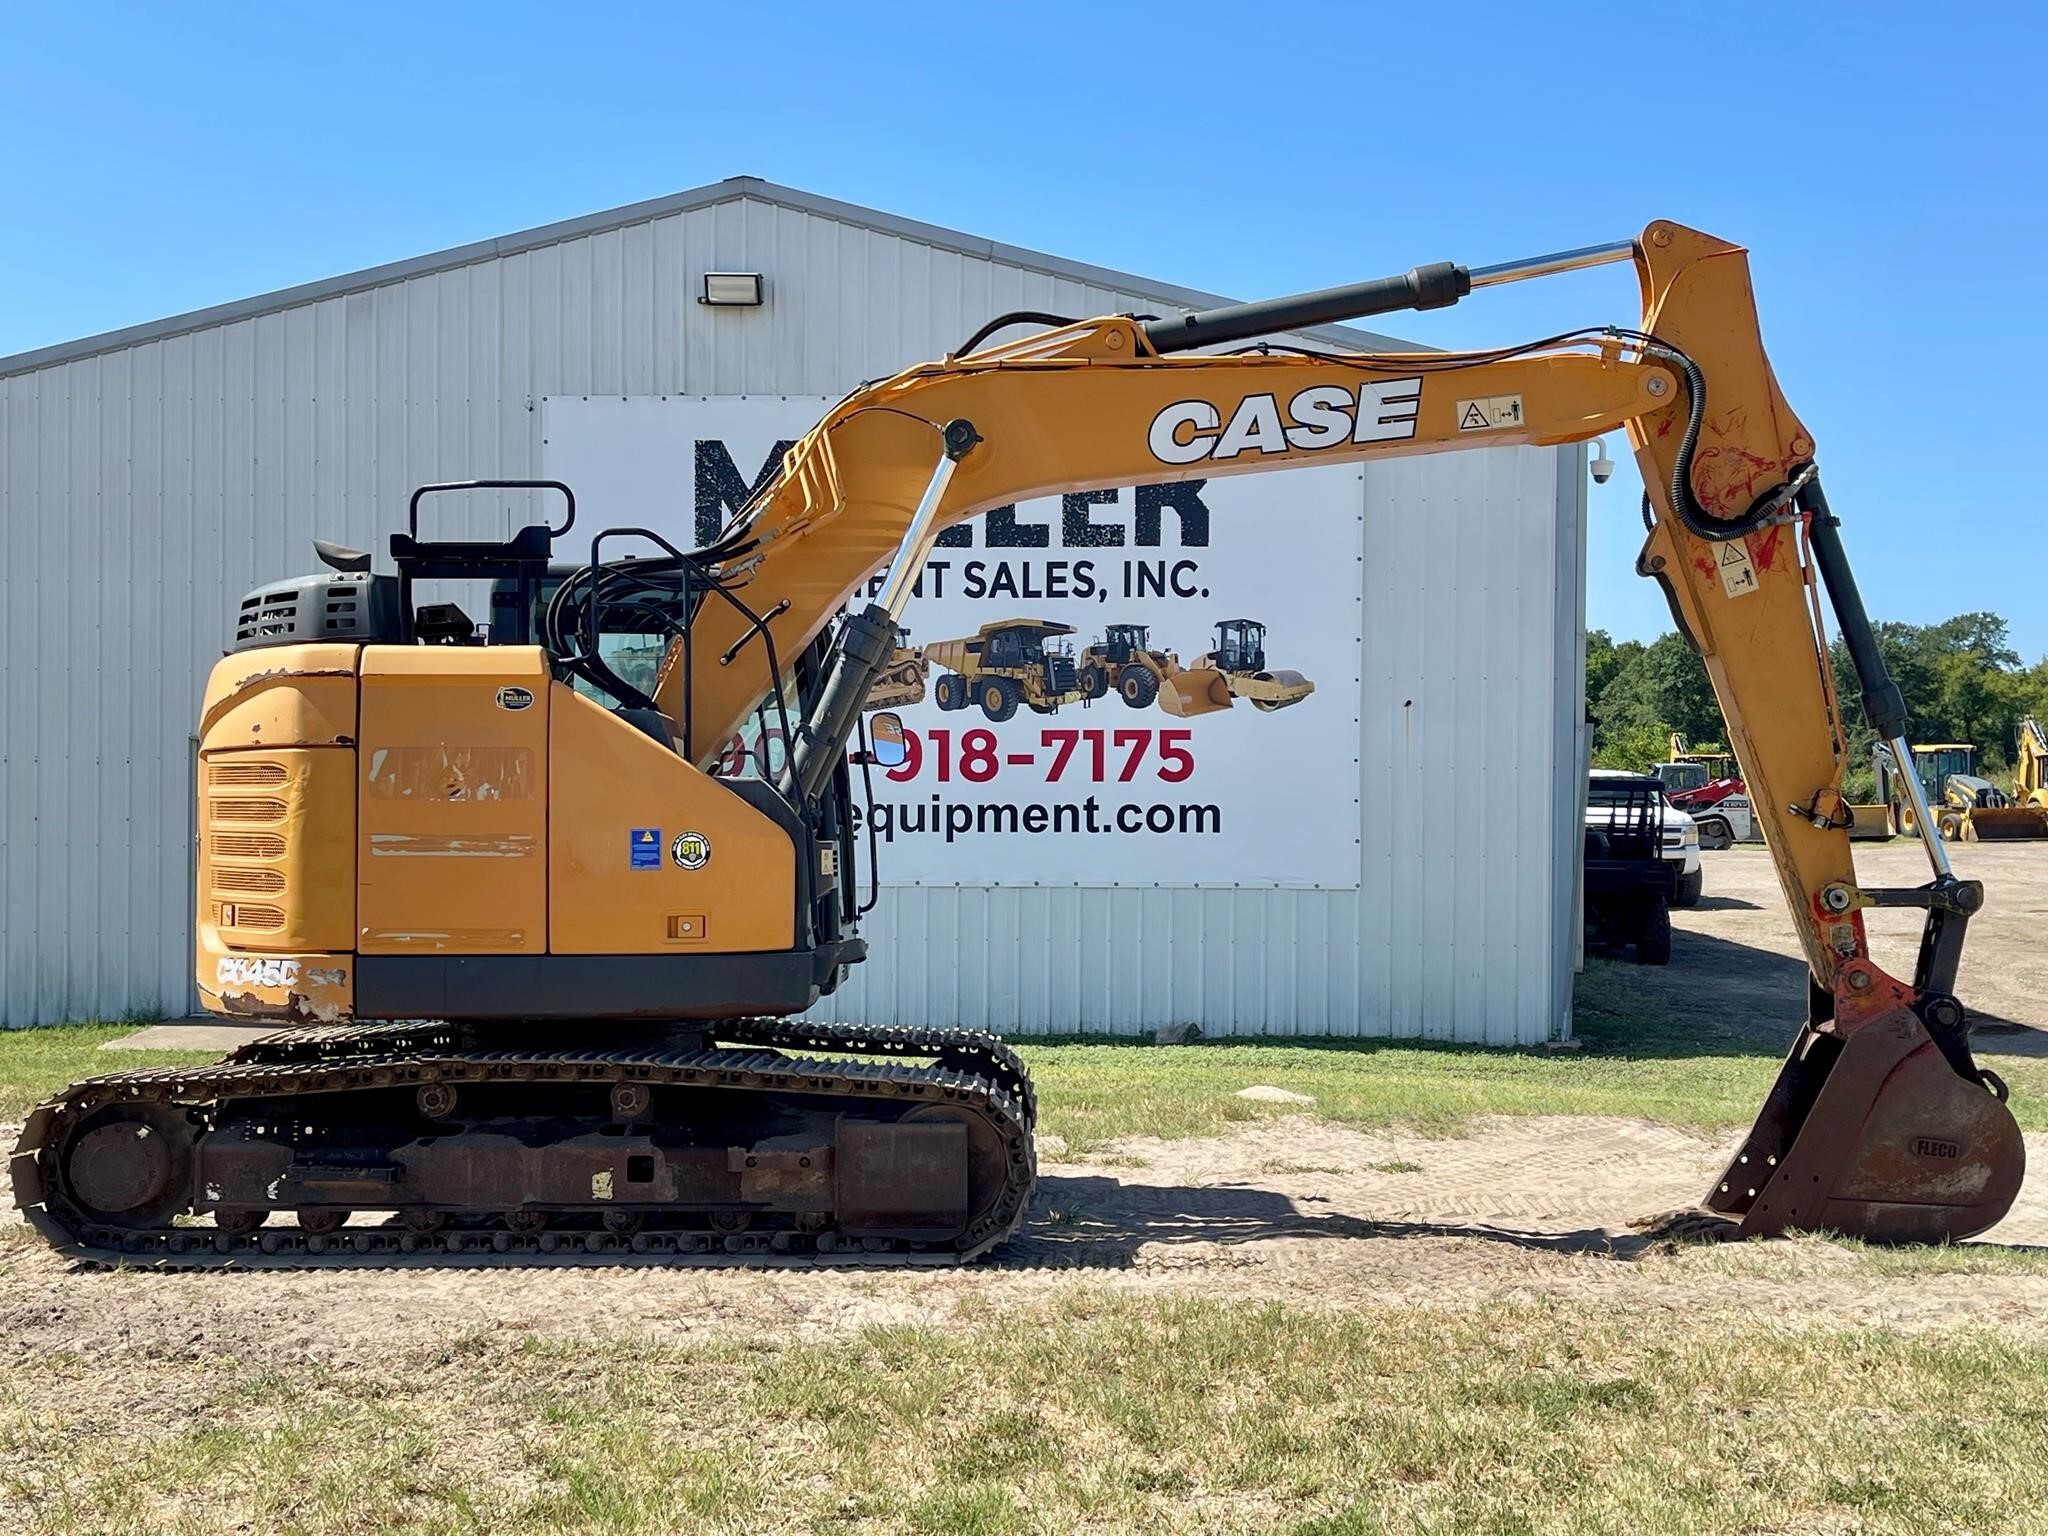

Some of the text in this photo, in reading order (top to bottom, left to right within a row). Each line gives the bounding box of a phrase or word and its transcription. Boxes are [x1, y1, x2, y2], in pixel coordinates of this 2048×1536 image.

[1148, 376, 1423, 465] CASE
[963, 560, 1107, 603] SALES,
[1124, 560, 1210, 598] INC.
[682, 841, 700, 855] 811
[1917, 1140, 1957, 1158] FLECO
